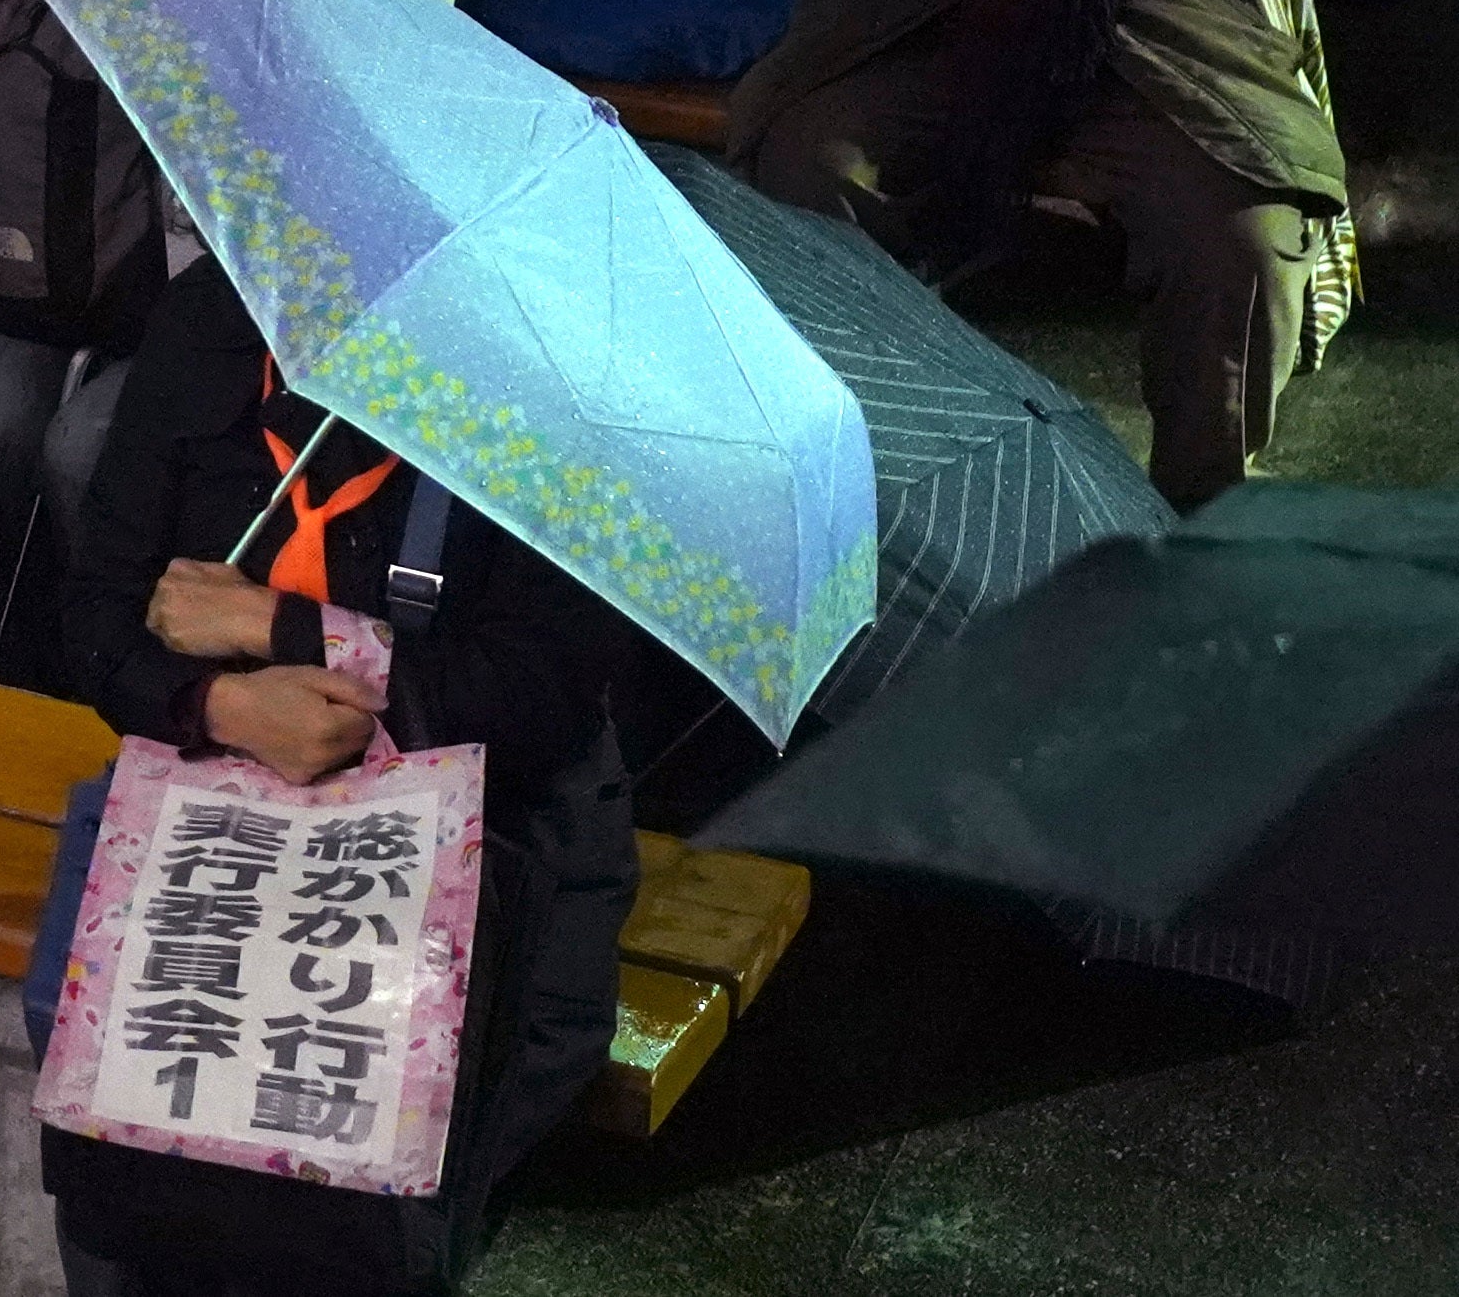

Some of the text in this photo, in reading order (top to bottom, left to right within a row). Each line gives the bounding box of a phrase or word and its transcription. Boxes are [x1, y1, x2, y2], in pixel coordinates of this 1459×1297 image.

[124, 802, 293, 1119] 実行委員会1
[250, 809, 423, 1145] 総がかり行動
